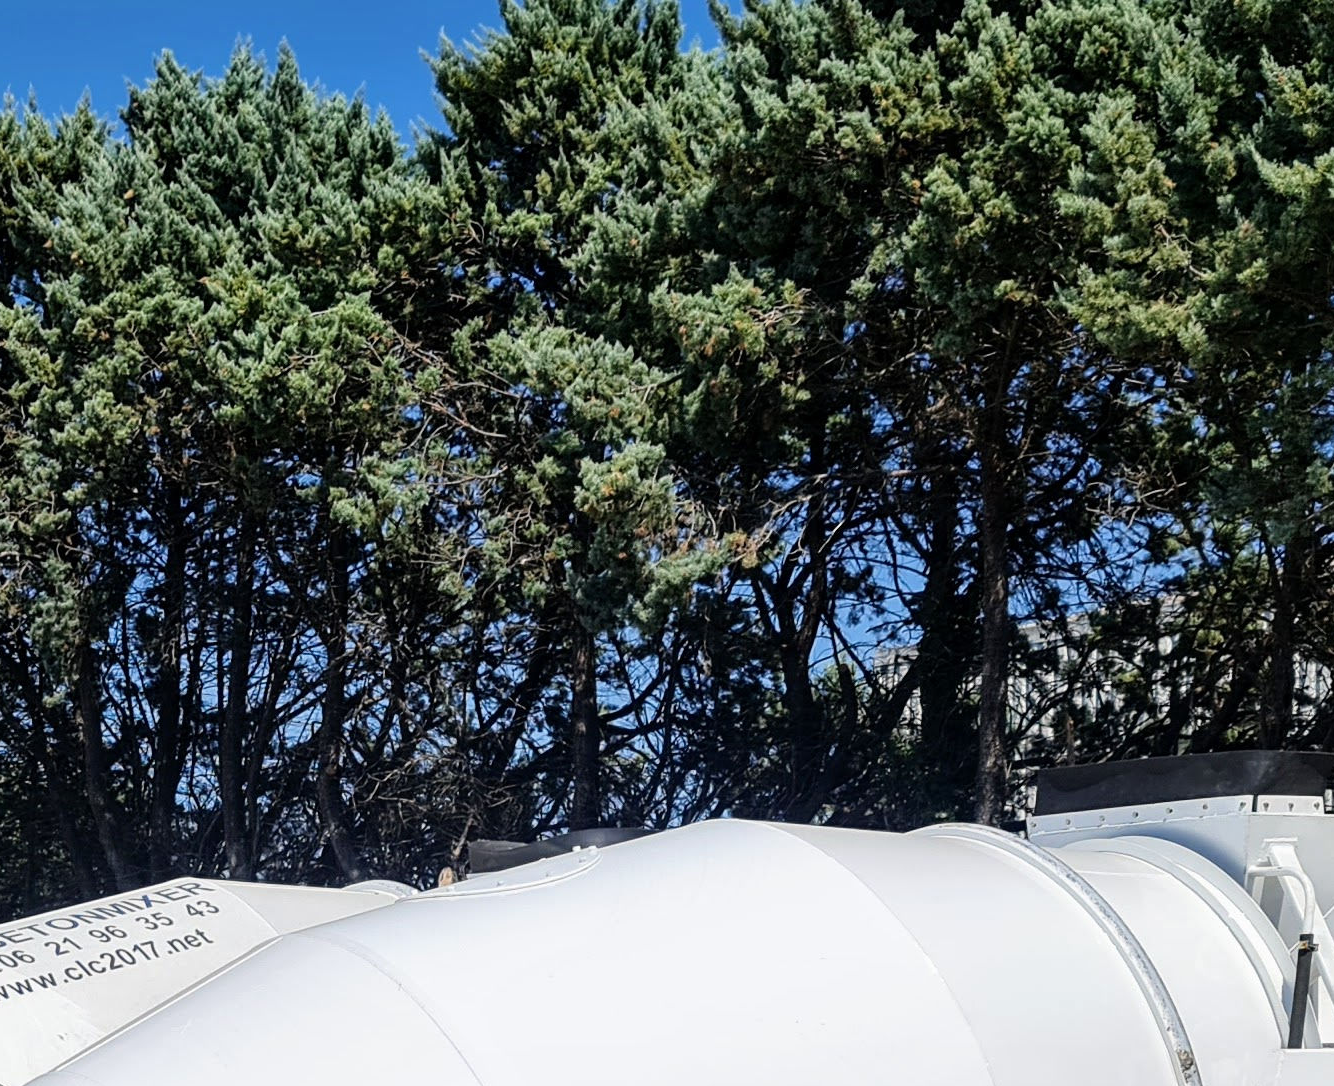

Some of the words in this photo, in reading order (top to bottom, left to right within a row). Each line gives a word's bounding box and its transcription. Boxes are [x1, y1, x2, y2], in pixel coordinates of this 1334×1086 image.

[44, 937, 83, 956] 21
[88, 925, 127, 943] 96
[135, 912, 174, 930] 35
[185, 900, 220, 917] 43
